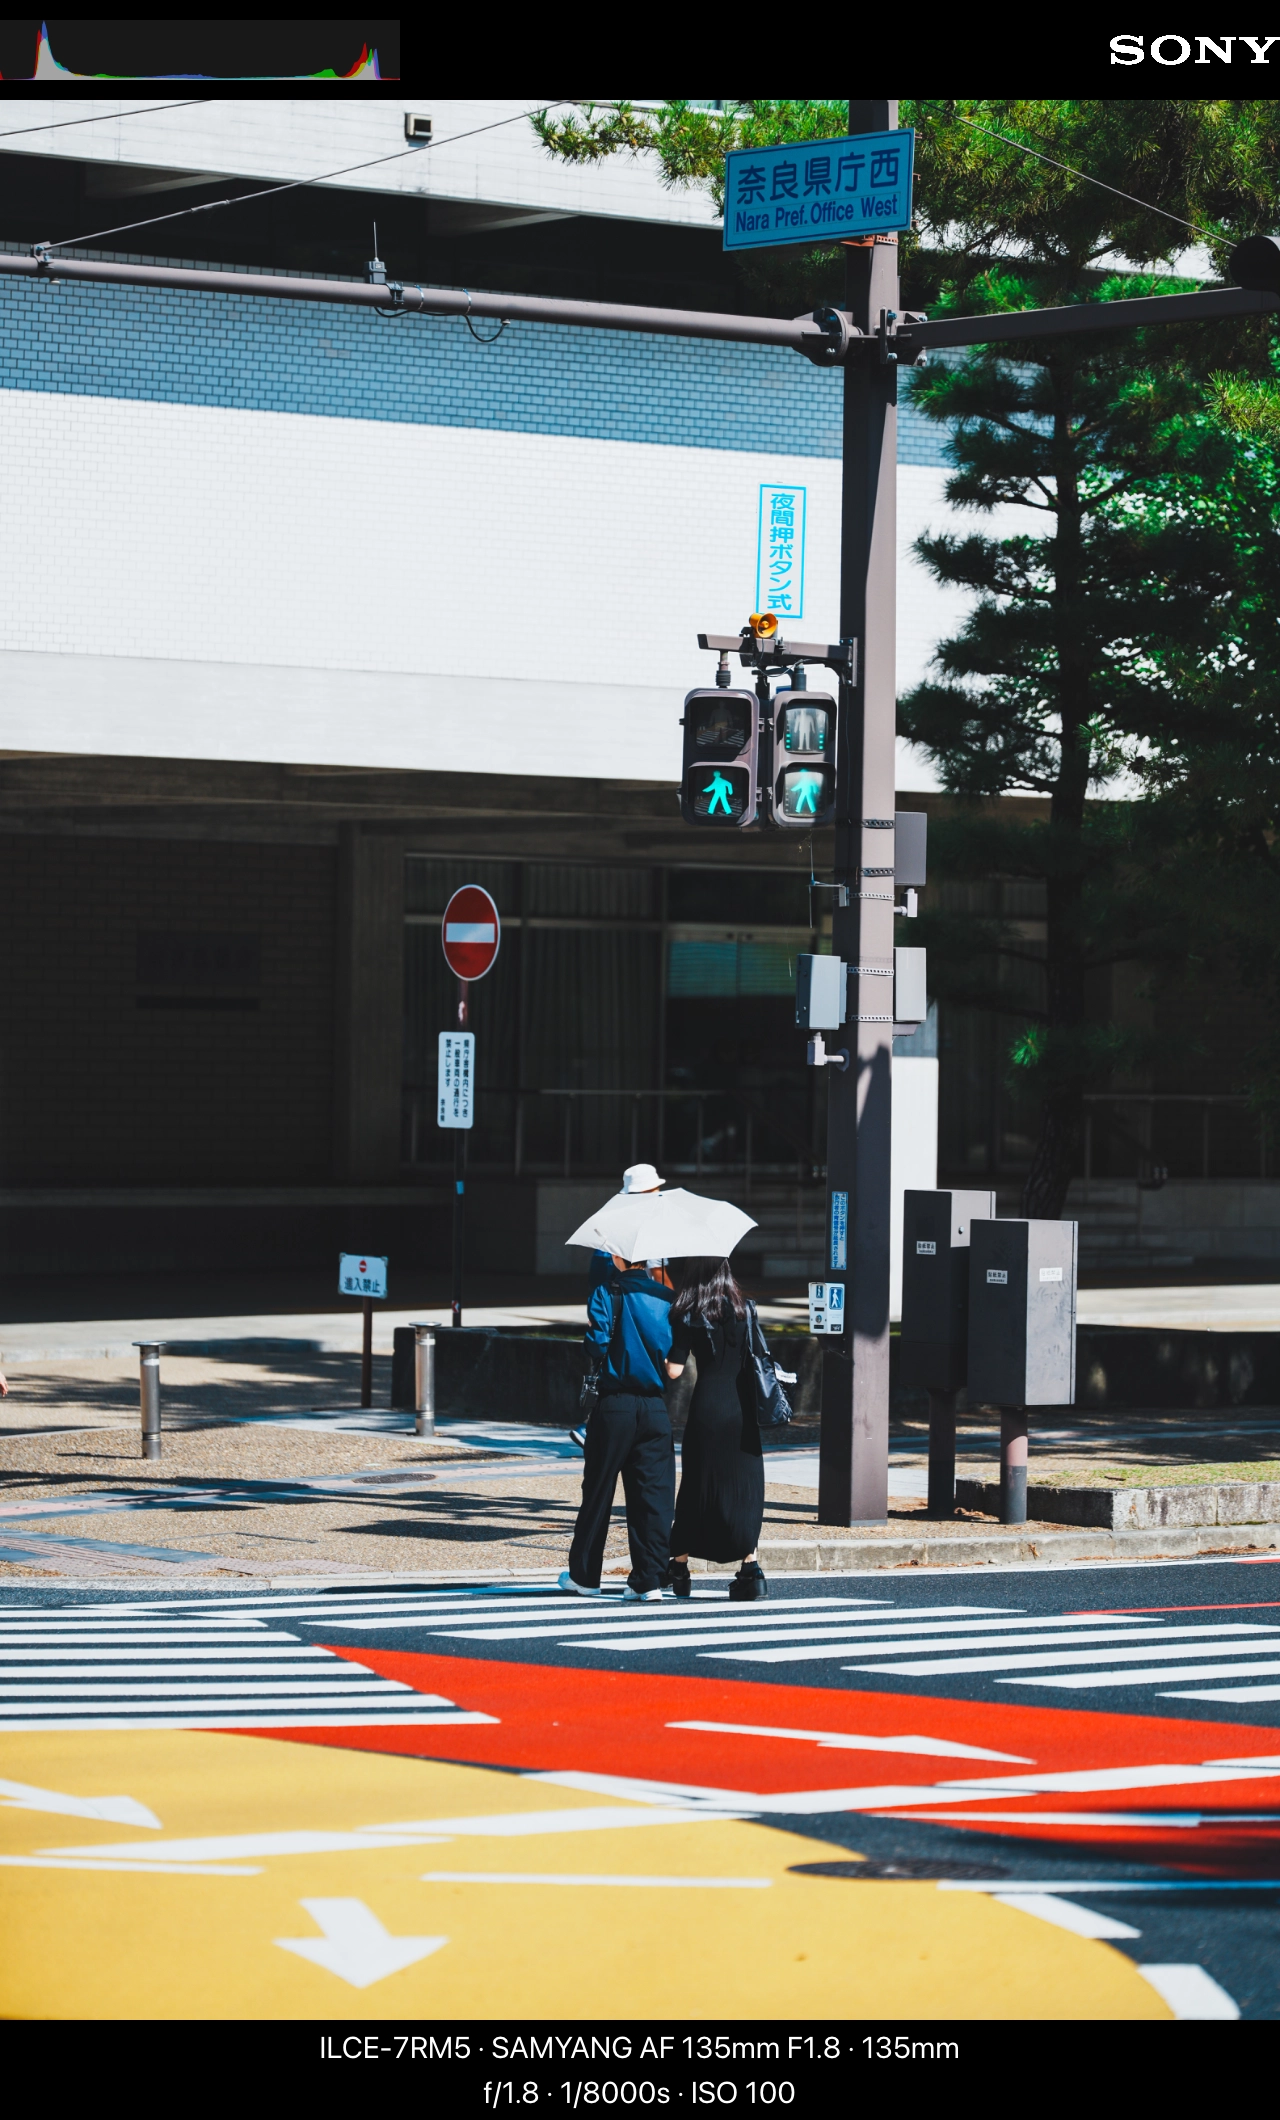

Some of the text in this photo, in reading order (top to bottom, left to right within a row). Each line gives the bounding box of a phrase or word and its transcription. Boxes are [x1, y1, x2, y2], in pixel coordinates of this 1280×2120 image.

[736, 148, 900, 205] 奈良県庁西
[735, 194, 897, 232] Nara Pref. Office West
[767, 493, 795, 610] 夜間押ボタン式
[344, 1276, 380, 1293] 進入禁止
